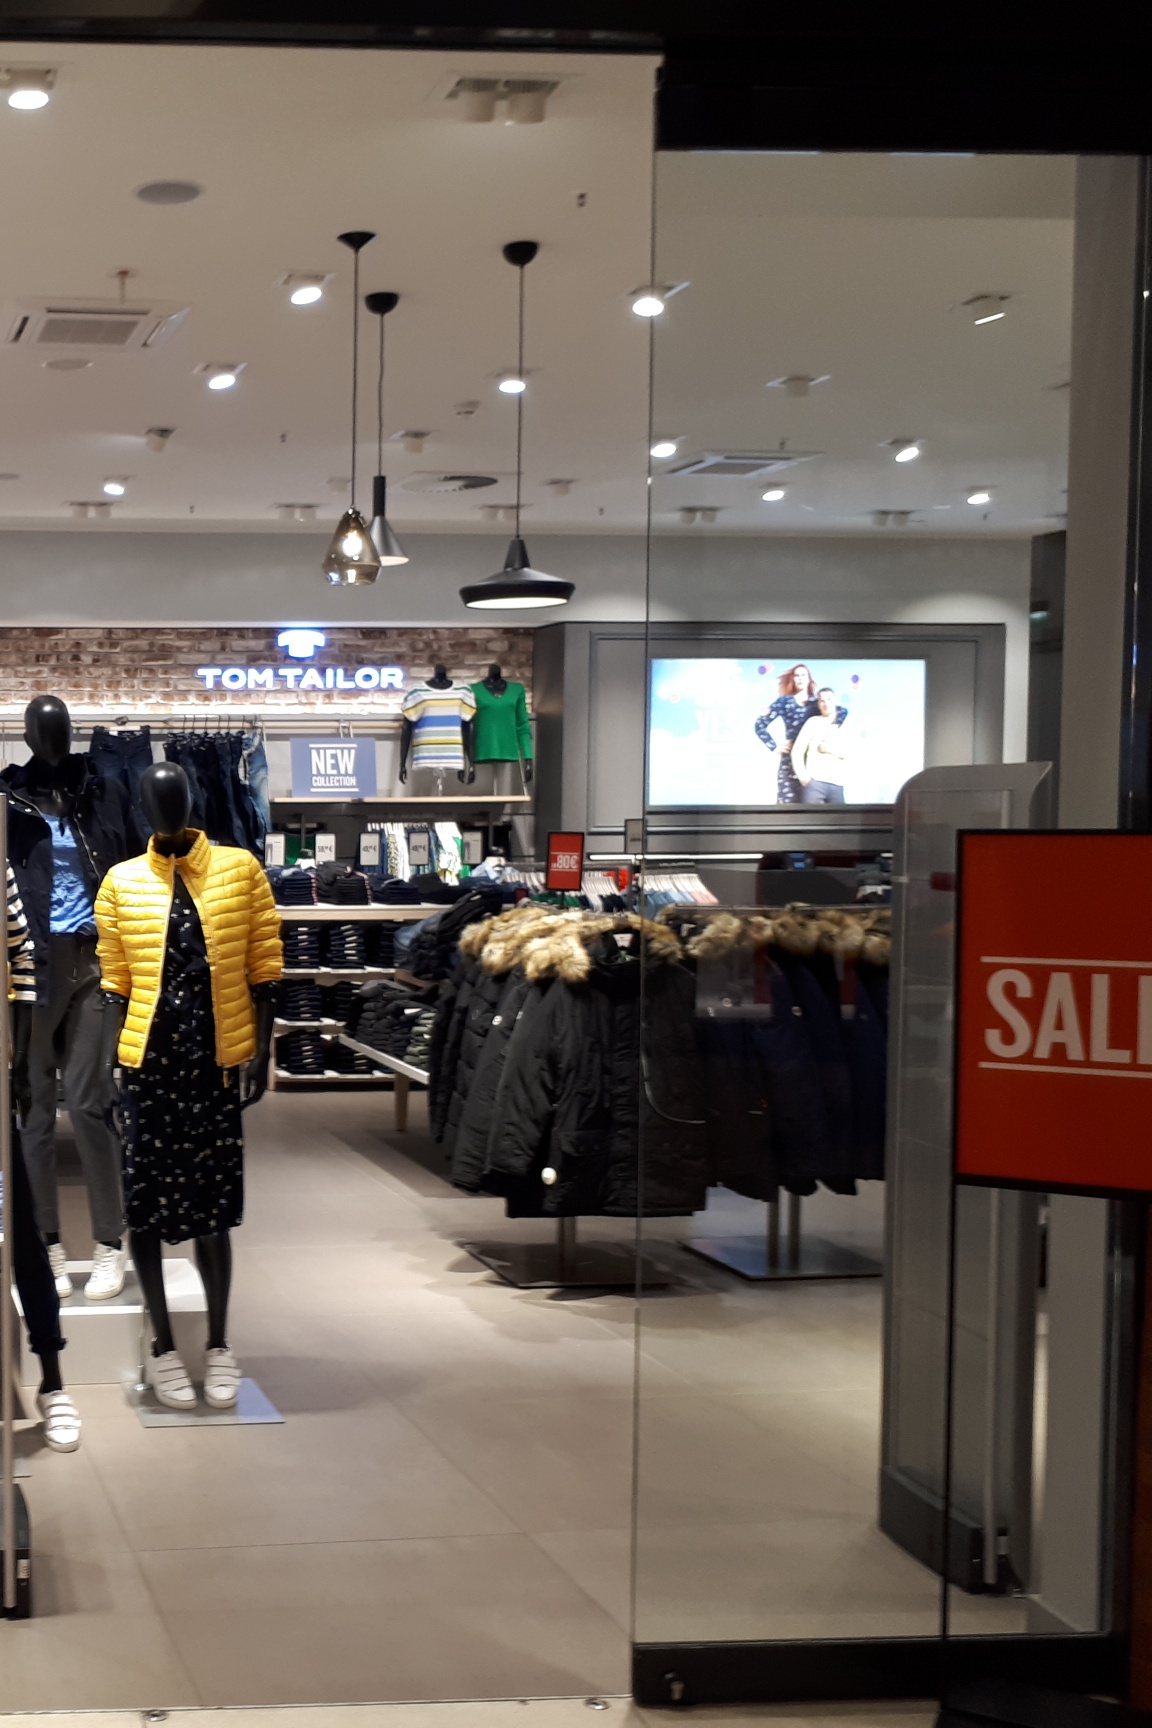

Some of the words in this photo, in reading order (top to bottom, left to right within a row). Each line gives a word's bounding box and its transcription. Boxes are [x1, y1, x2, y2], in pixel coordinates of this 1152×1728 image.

[197, 668, 273, 689] TOM
[278, 667, 403, 689] TAILOR
[309, 749, 356, 775] NEW
[312, 776, 356, 787] COLLECTION
